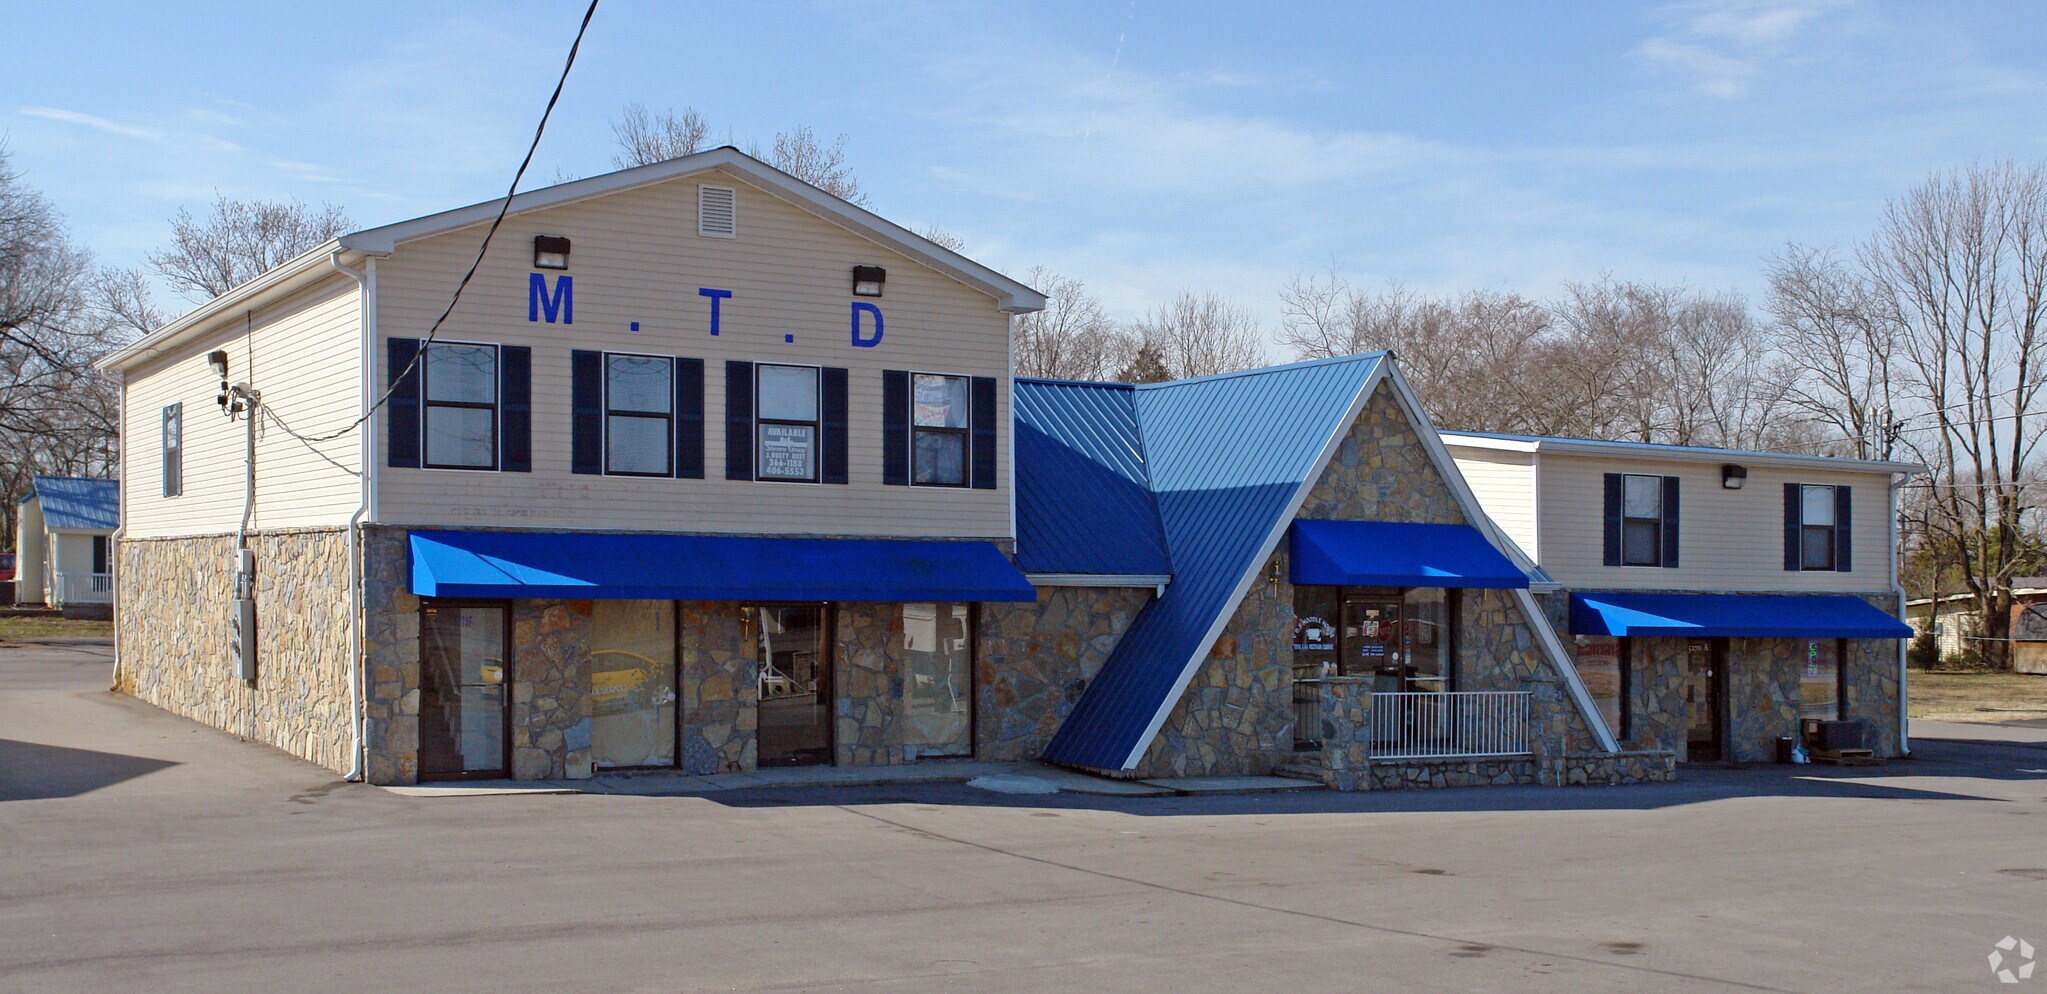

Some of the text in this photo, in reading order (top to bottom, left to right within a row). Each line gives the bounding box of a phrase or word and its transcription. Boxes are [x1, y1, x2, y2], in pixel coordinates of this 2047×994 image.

[768, 428, 806, 437] AVAILABLE
[768, 459, 802, 468] 366-1188
[766, 466, 804, 475] 406-5553
[1809, 642, 1818, 675] OPEN
